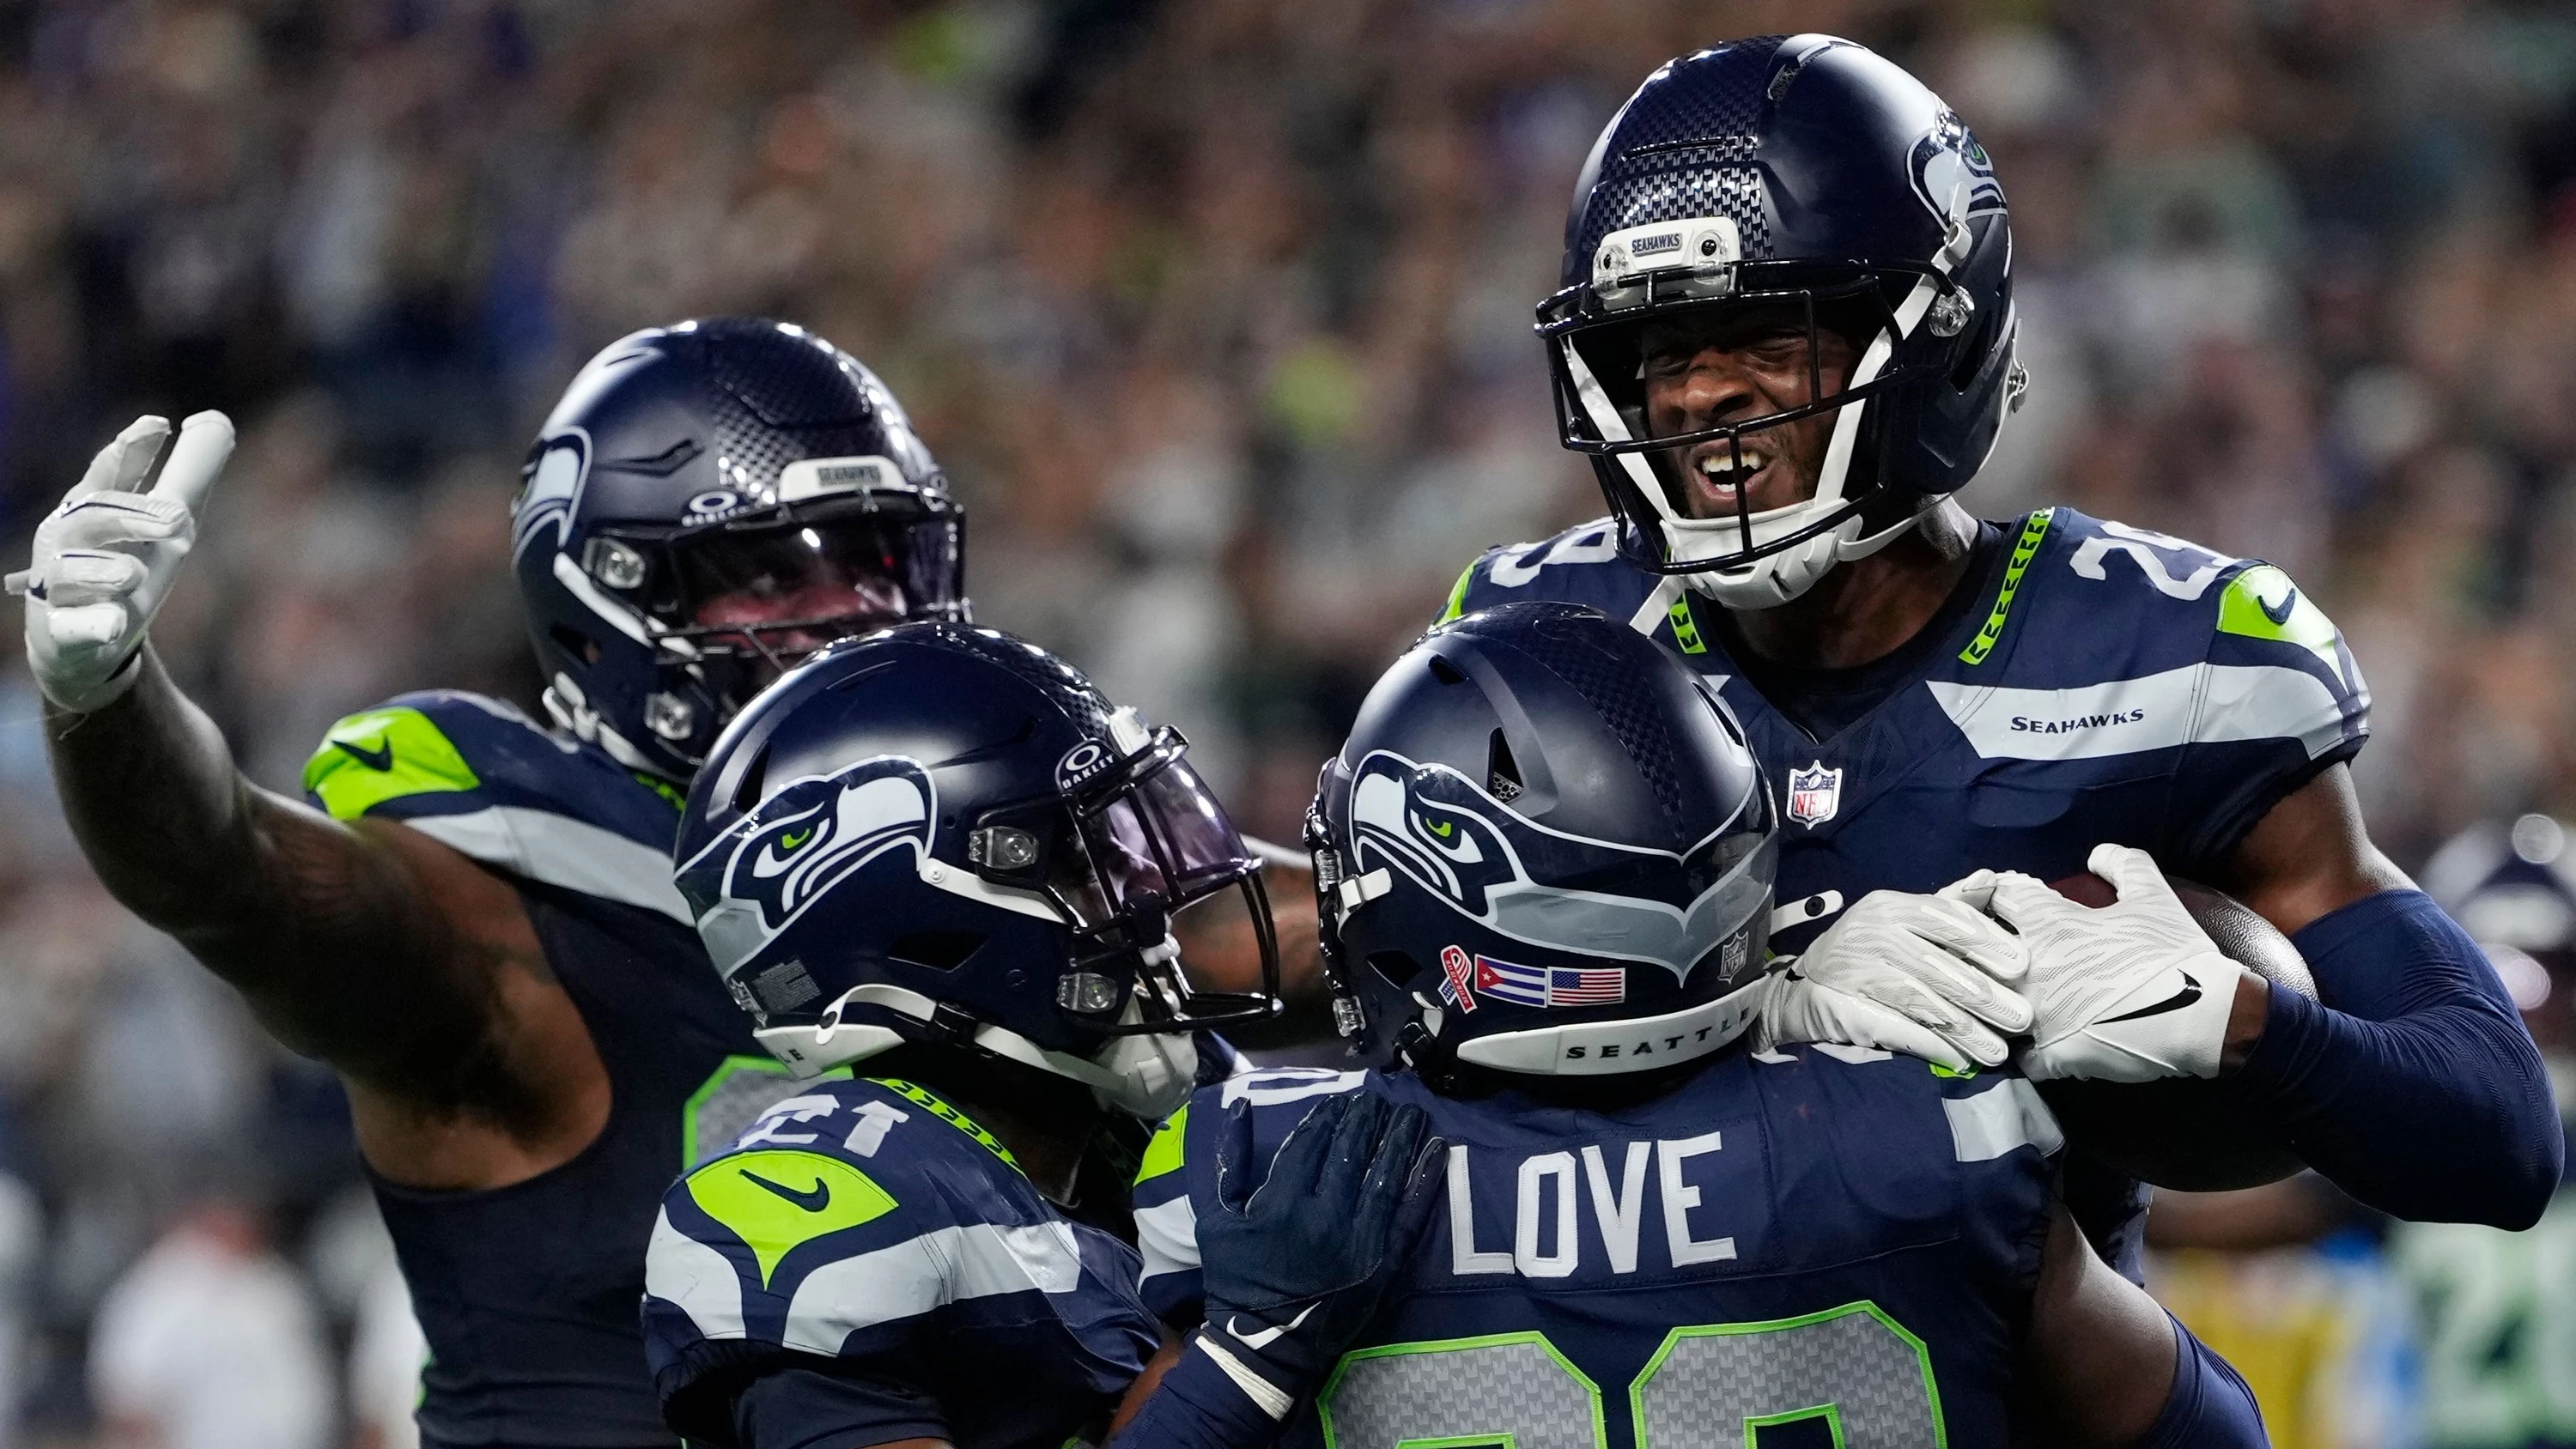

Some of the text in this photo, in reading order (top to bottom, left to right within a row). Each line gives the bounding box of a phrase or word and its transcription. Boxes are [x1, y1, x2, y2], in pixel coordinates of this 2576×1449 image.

[1631, 233, 1680, 254] SEAHAWKS
[2010, 708, 2145, 734] SEAHAWKS
[1061, 754, 1115, 789] OAKLEY
[1564, 1006, 1750, 1059] SEATTLE
[1447, 1131, 1738, 1278] LOVE
